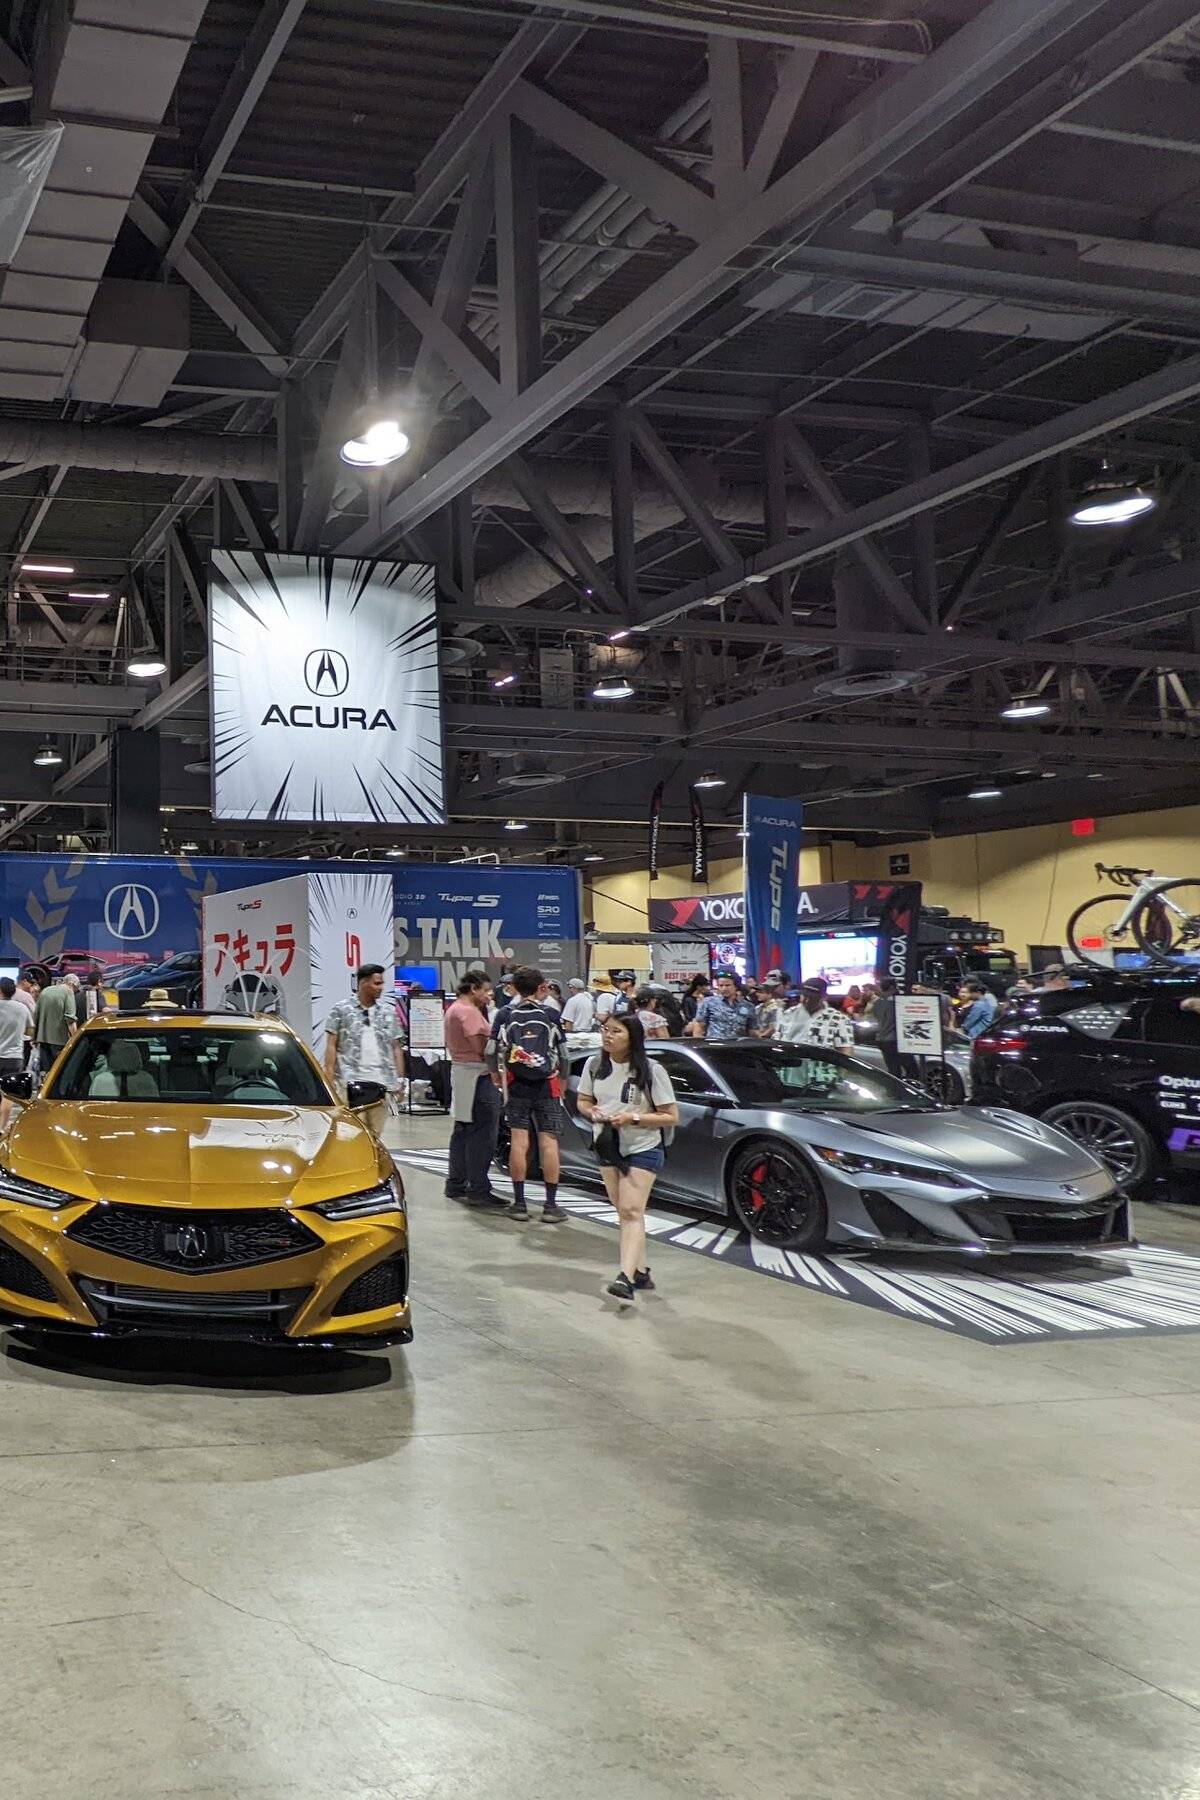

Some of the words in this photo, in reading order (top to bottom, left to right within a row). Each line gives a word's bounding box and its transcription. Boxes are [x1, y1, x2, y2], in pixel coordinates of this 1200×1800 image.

[260, 704, 397, 731] ACURA
[761, 816, 798, 829] ACURA
[537, 905, 561, 914] SRO
[416, 917, 515, 959] TALK.
[214, 923, 296, 977] アキュラ
[1030, 1025, 1069, 1033] ACURA
